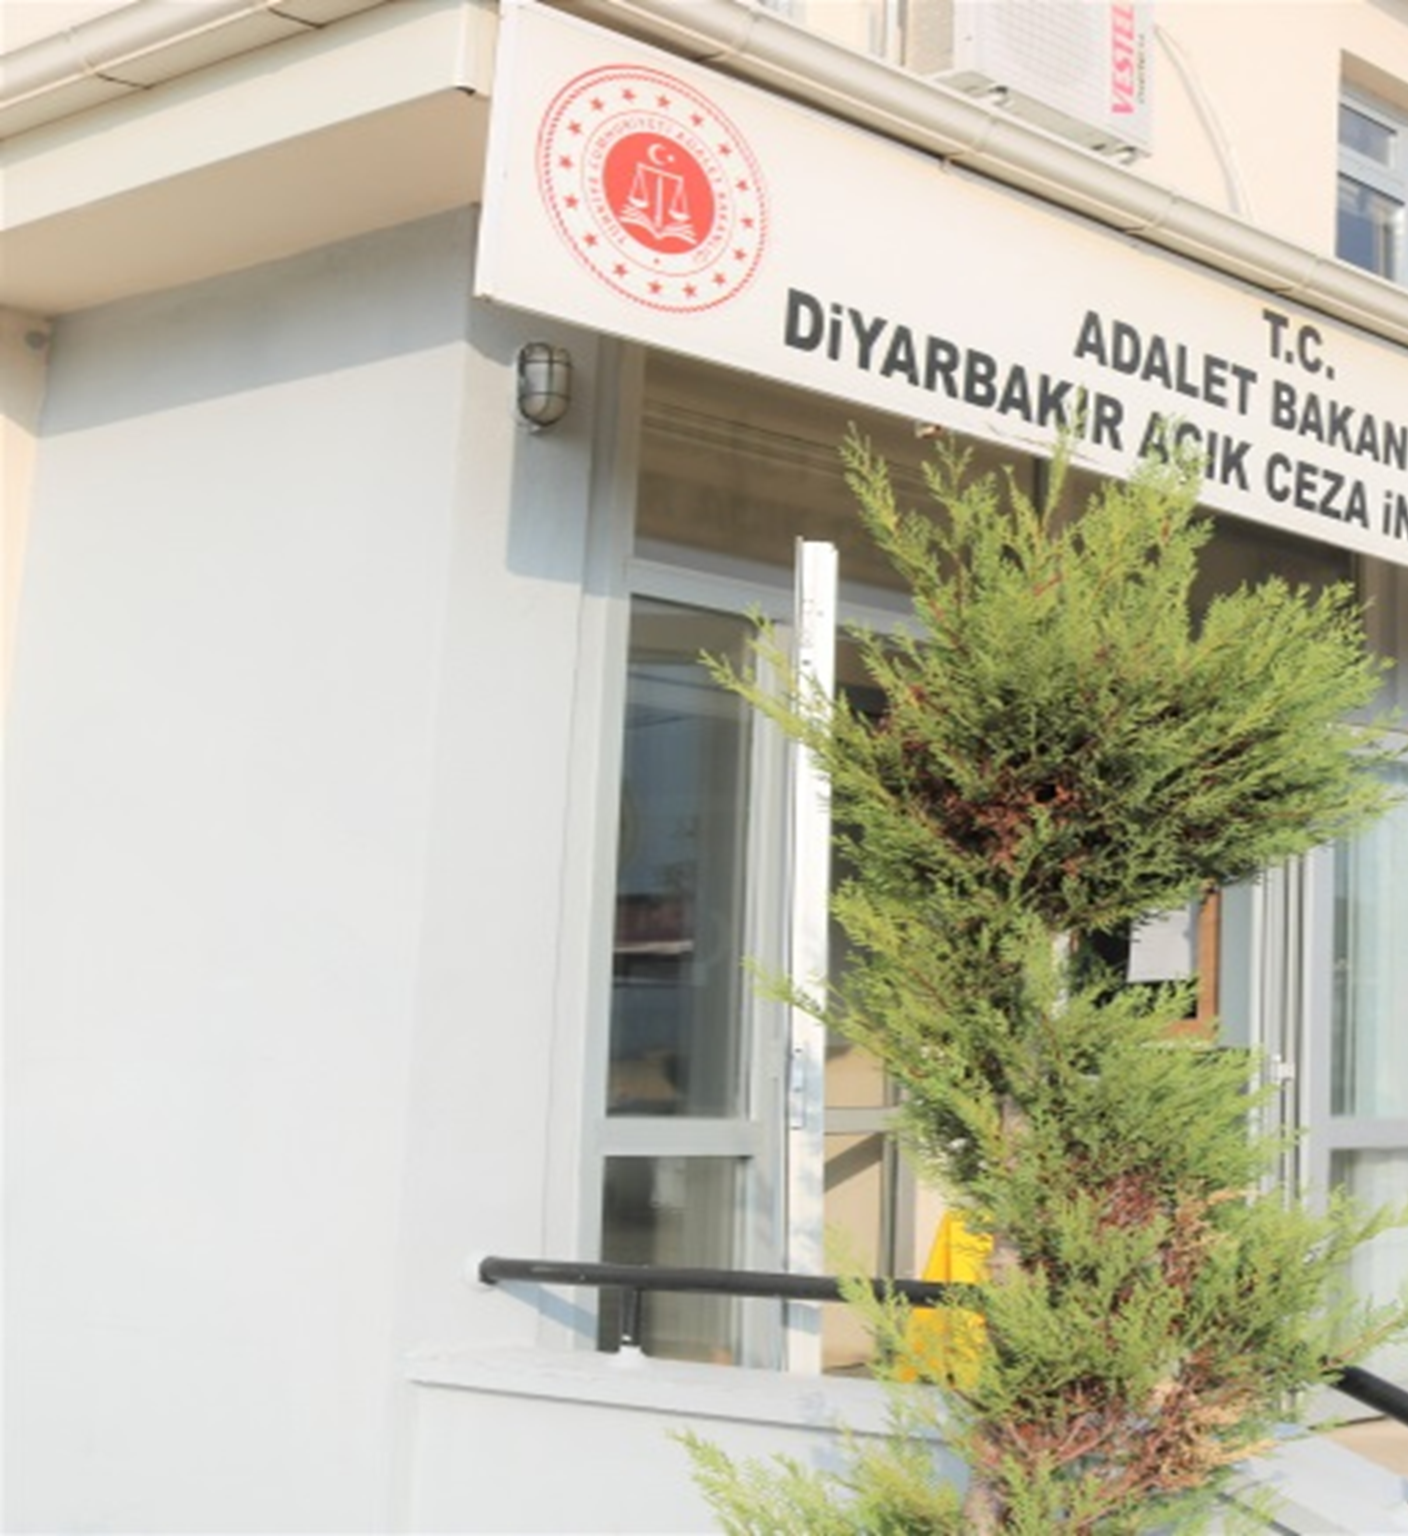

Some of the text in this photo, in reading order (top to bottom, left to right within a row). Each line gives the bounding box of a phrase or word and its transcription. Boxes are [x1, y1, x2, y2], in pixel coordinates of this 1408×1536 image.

[1109, 3, 1135, 114] VESTEL
[1074, 311, 1258, 415] ADALET
[1263, 309, 1334, 379] T.C.
[1265, 453, 1369, 529] CEZA
